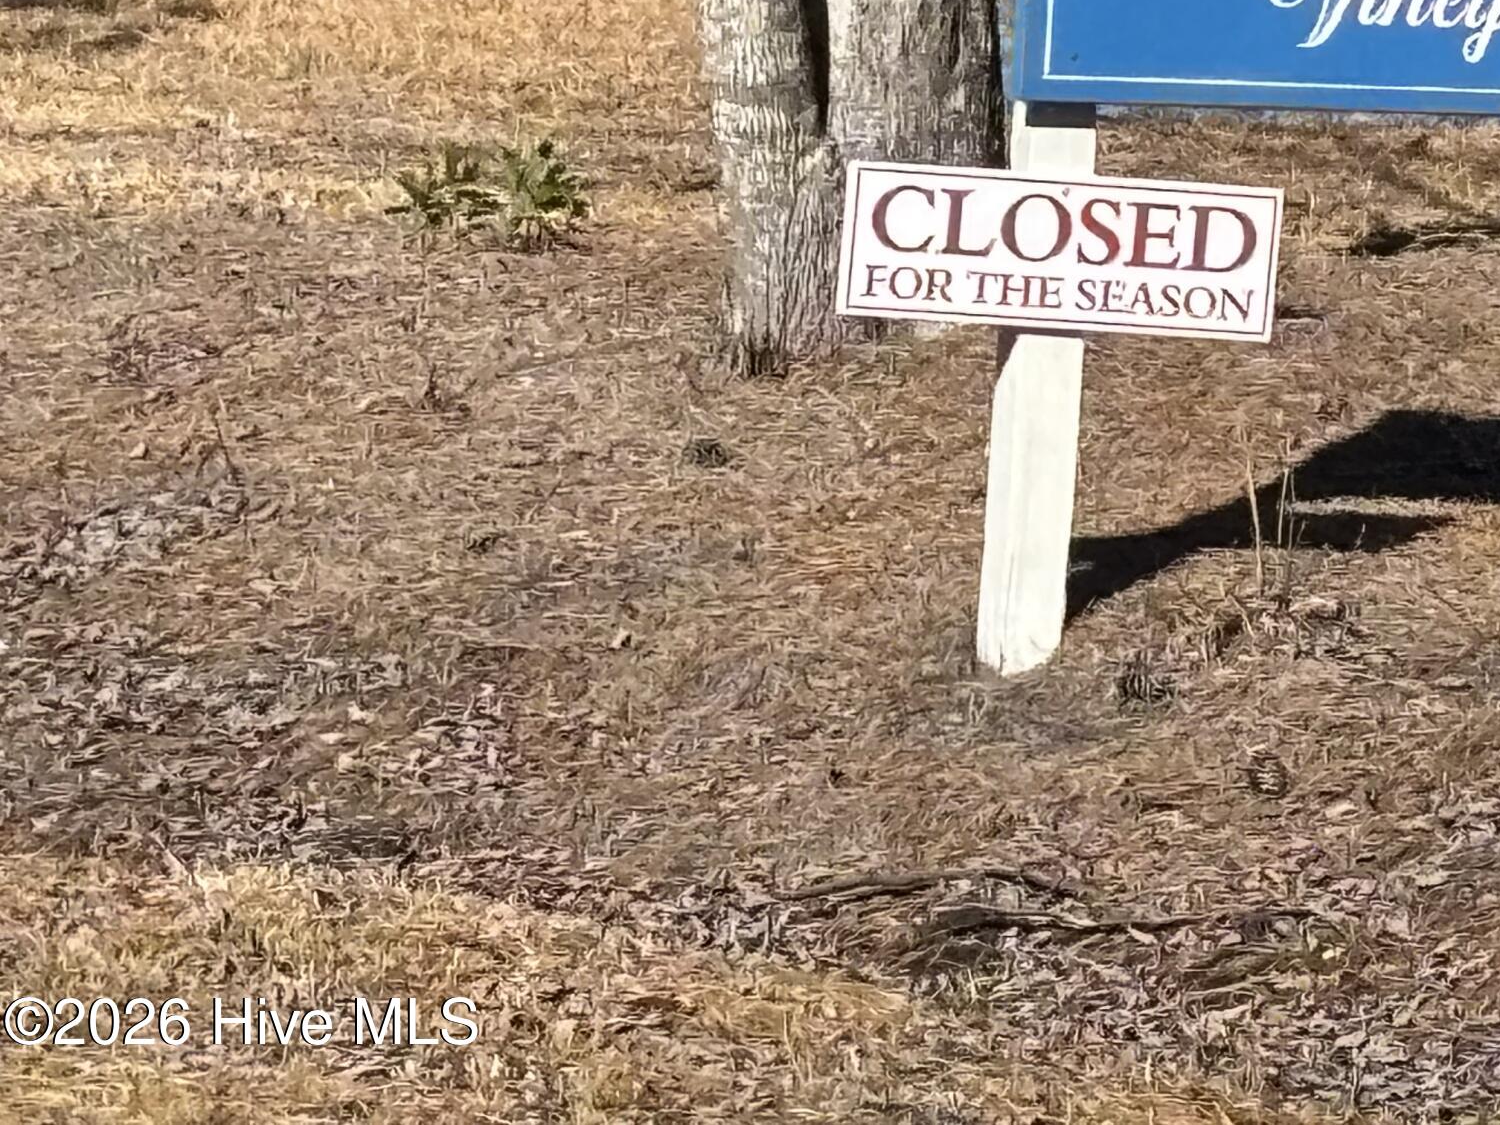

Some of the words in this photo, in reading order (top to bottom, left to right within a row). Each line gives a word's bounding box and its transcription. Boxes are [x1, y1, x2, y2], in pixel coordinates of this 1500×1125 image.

[872, 185, 1257, 273] CLOSED
[860, 264, 954, 303] FOR
[967, 270, 1065, 309] THE
[1075, 278, 1254, 323] SEASON
